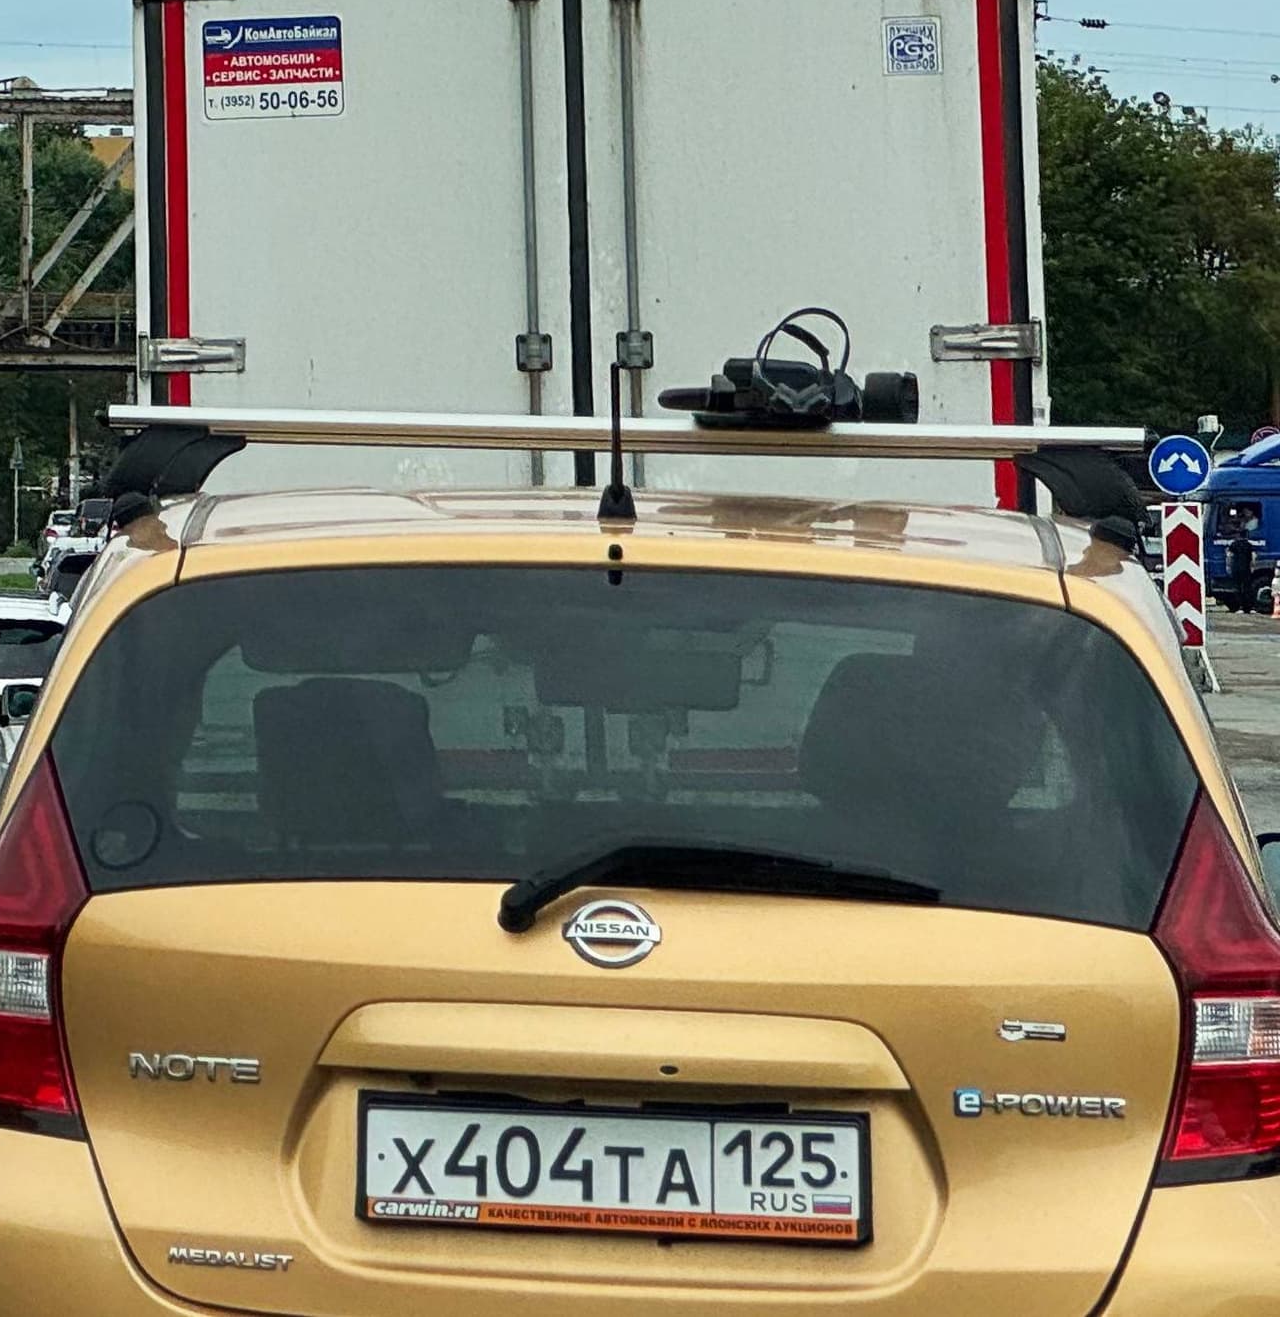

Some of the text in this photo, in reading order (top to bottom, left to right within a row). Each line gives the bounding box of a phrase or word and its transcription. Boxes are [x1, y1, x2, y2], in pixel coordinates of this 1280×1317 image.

[244, 26, 338, 41] КомАвтоБайкал
[230, 53, 315, 67] АВТОМОБИЛИ
[212, 67, 334, 82] СЕРВИС ЗАПЧАСТИ
[221, 95, 256, 110] (3952)
[259, 89, 339, 110] 50-06-56
[574, 923, 650, 937] NISSAN
[129, 1052, 260, 1083] NOTE
[722, 1129, 837, 1189] 125
[373, 1200, 479, 1220] carwin.ru
[750, 1192, 808, 1213] RUS
[488, 1209, 592, 1224] КАЧЕСТВЕННЫЕ
[595, 1214, 684, 1228] АВТОМОБИЛИ
[700, 1219, 771, 1231] ЯПОНСКИХ
[774, 1222, 853, 1235] АУКЦИОНОВ
[168, 1246, 294, 1272] MEDALIST
